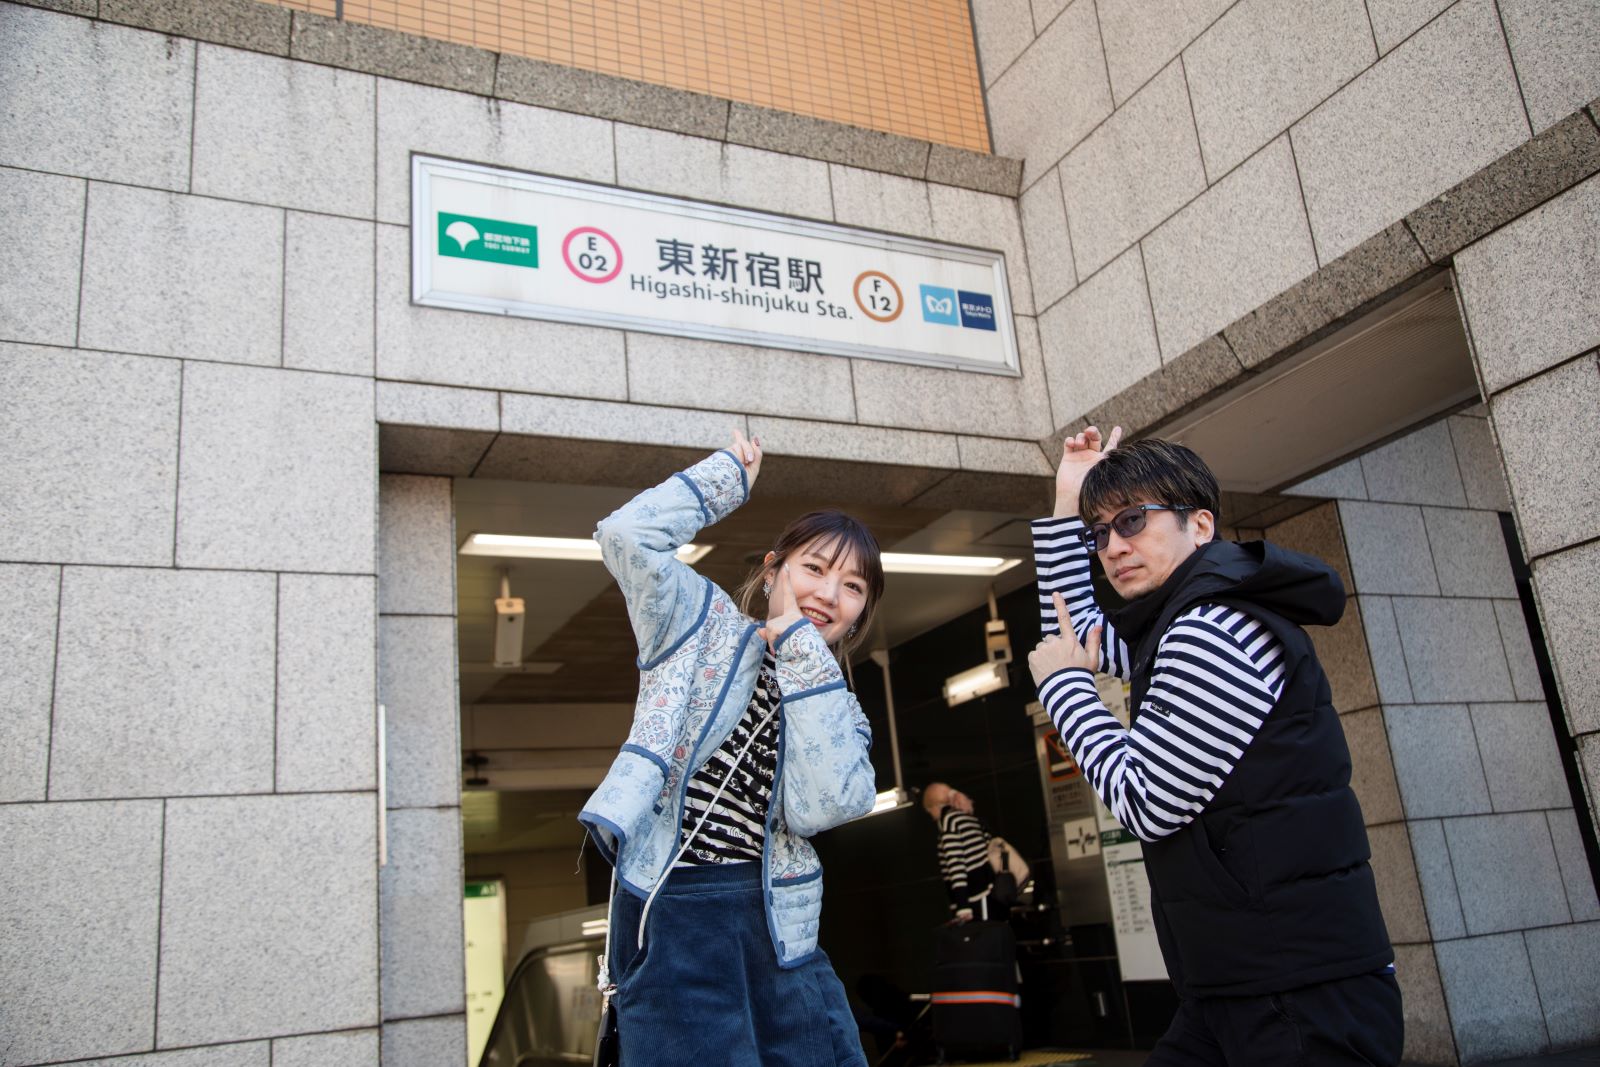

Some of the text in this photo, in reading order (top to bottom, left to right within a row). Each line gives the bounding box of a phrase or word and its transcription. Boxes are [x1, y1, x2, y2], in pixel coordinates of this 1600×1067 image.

[587, 237, 597, 251] E
[578, 253, 608, 272] 02
[656, 238, 824, 295] 東新宿駅
[873, 280, 881, 293] F
[630, 274, 854, 320] Higashi-shinjuku Sta.
[869, 295, 892, 312] 12
